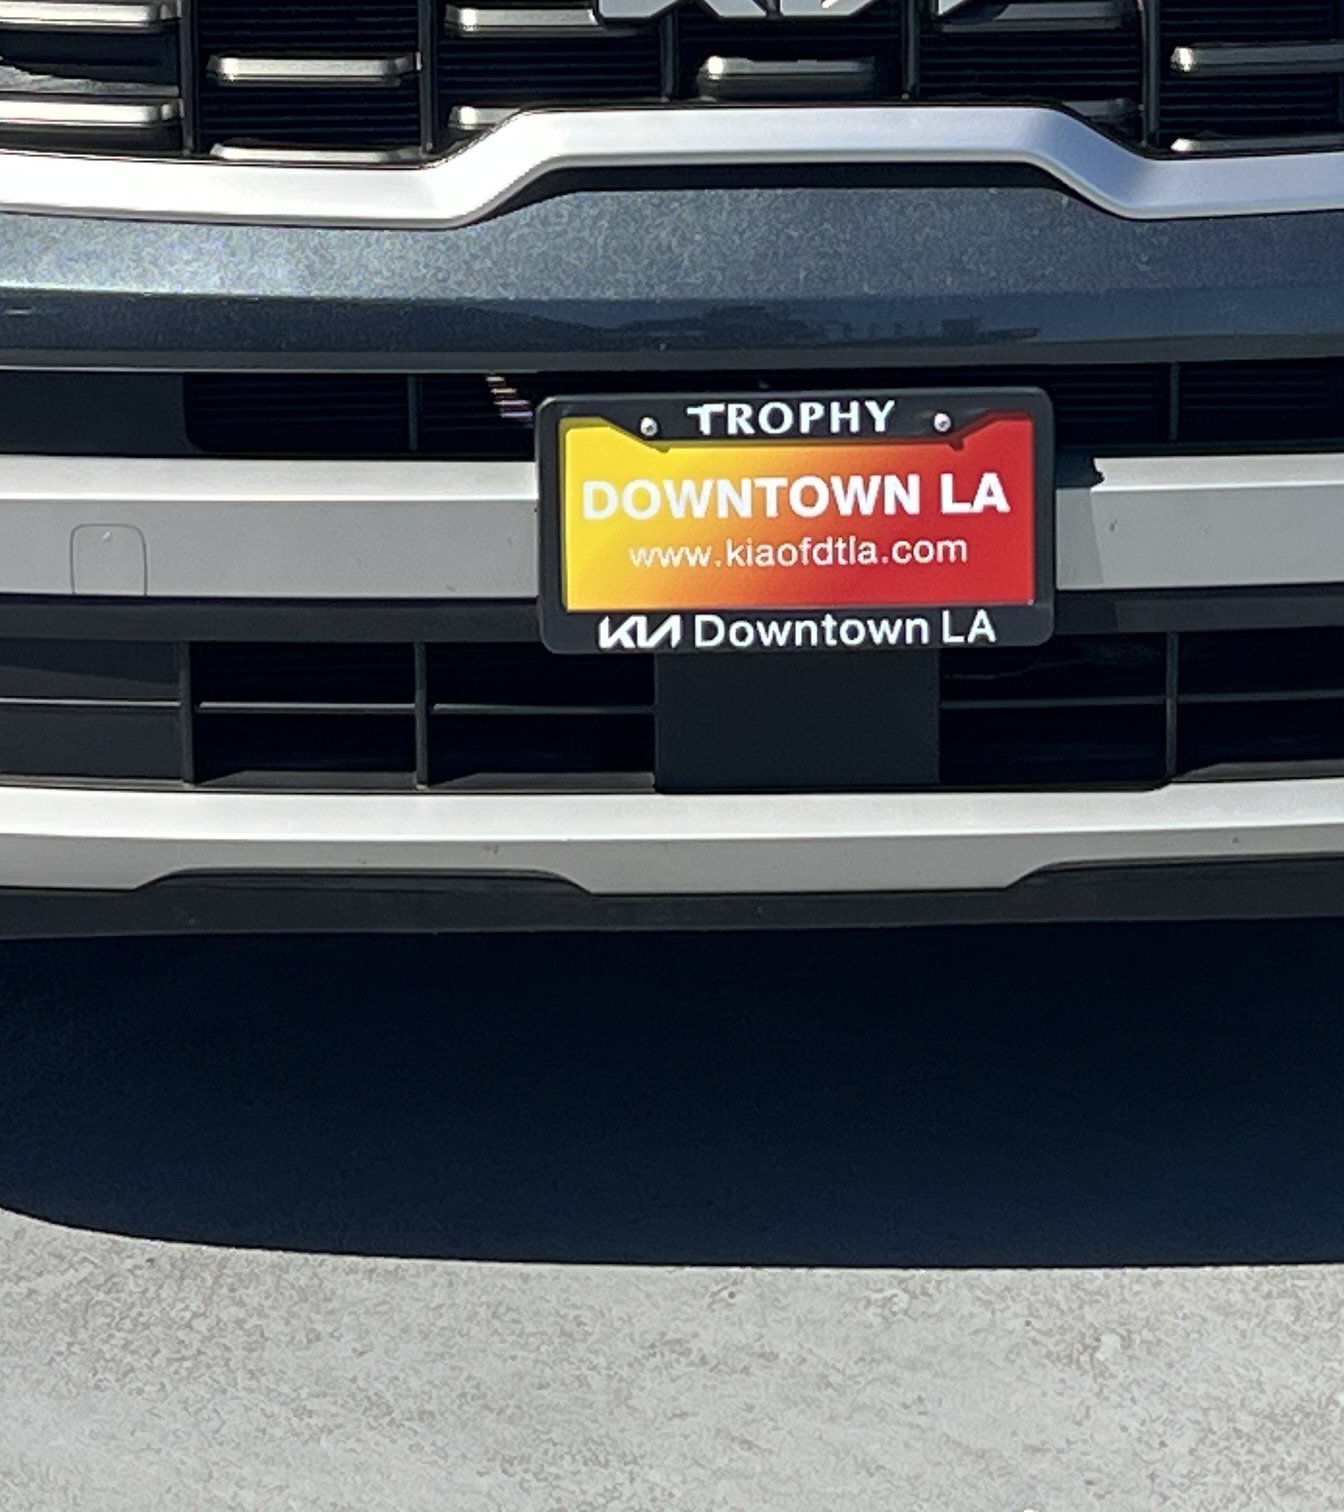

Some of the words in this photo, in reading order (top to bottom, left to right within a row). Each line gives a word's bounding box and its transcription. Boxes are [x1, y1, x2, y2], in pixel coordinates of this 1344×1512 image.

[686, 399, 896, 437] TROPHY
[582, 473, 921, 522] DOWNTOWN
[940, 471, 1011, 515] LA
[628, 535, 969, 569] www.kiaofdtla.com
[598, 614, 682, 650] KIA
[693, 613, 930, 648] Downtown
[941, 609, 997, 644] LA
